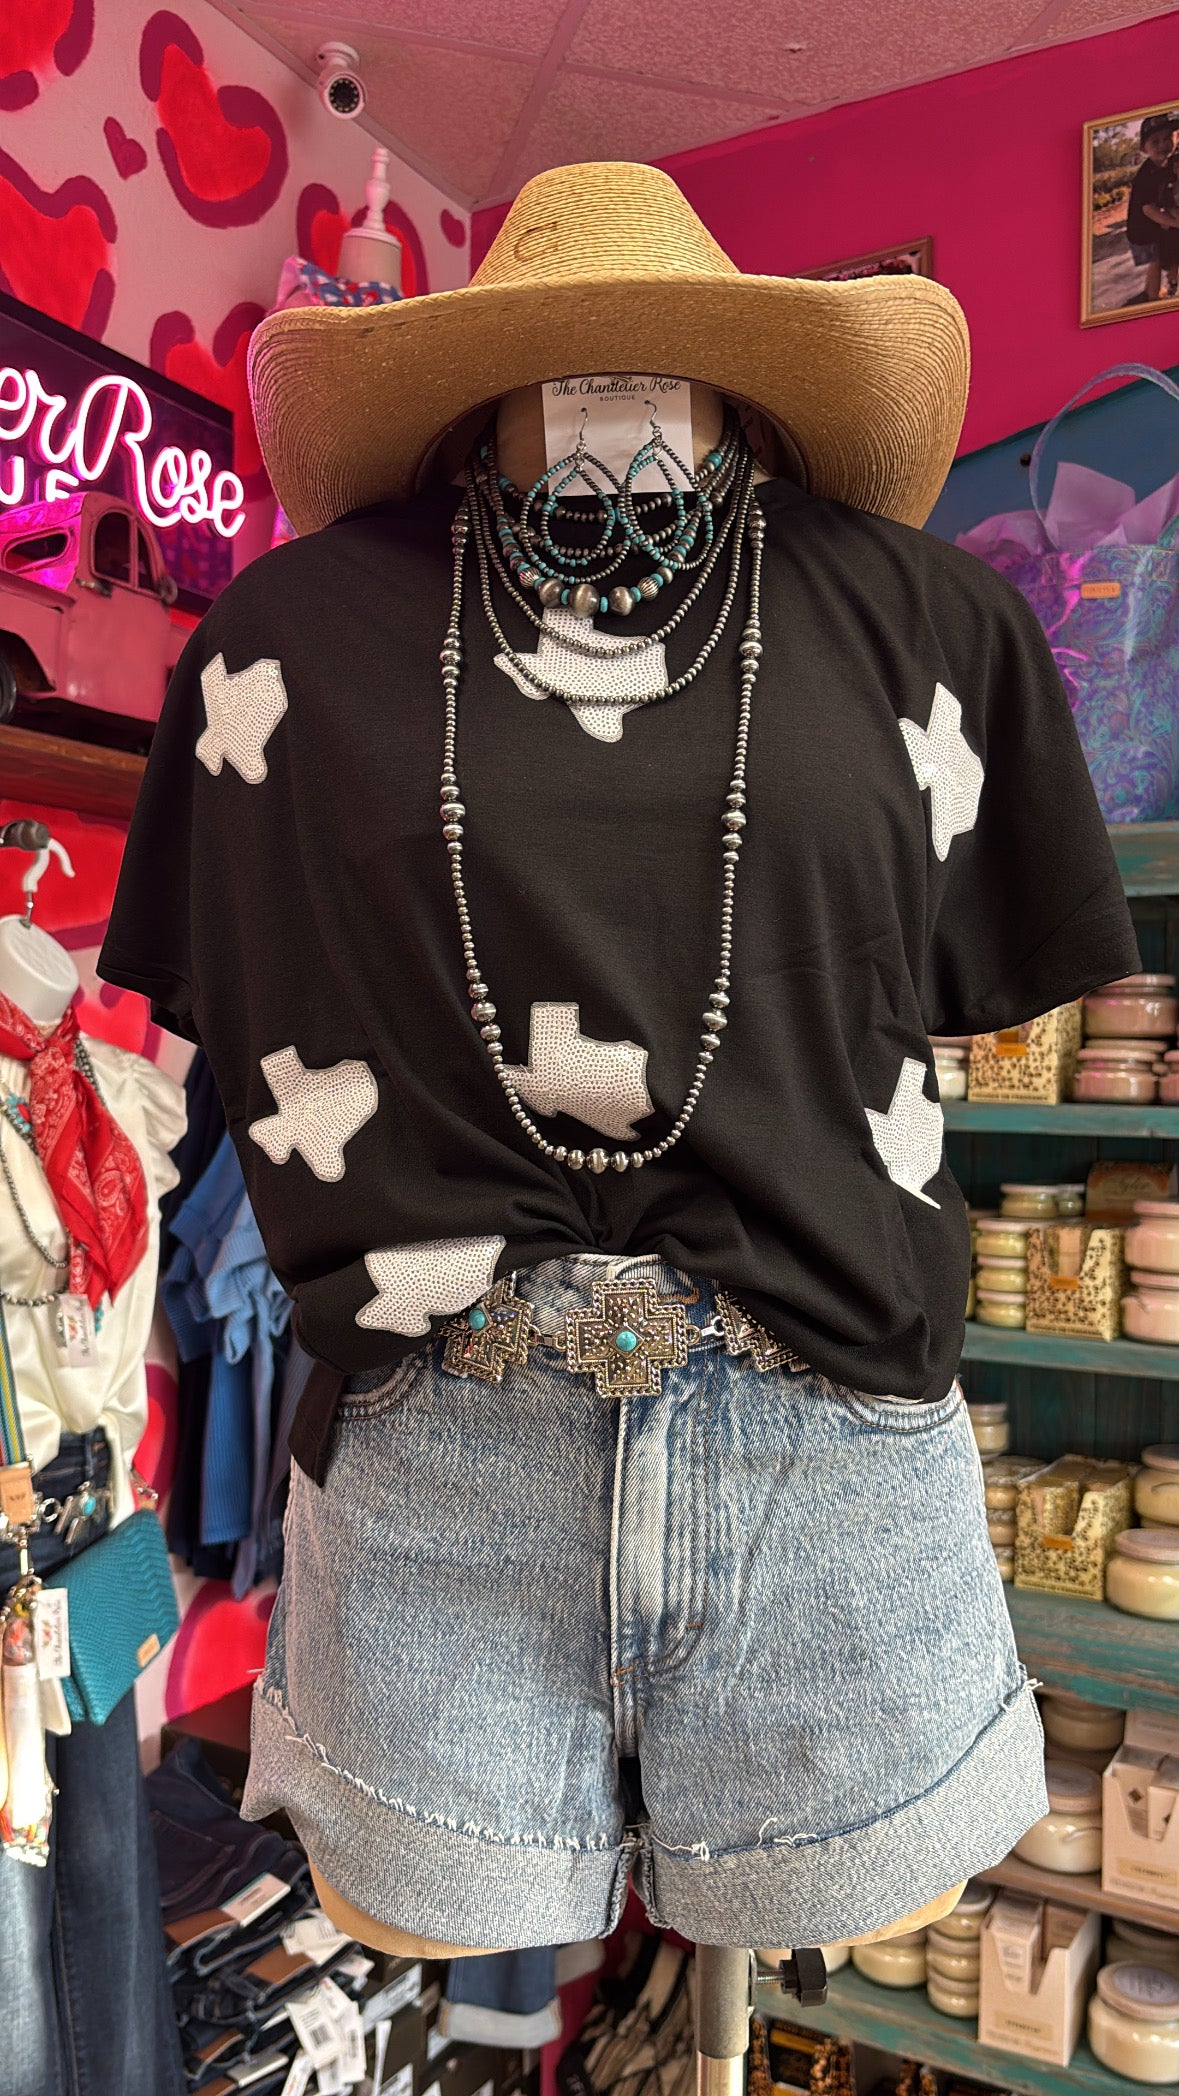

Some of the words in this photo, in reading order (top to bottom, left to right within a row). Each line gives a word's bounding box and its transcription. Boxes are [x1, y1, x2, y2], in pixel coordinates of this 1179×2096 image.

[552, 379, 577, 396] The
[649, 376, 681, 393] Rose
[599, 394, 636, 402] BOUTIQUE
[74, 374, 246, 538] Rose
